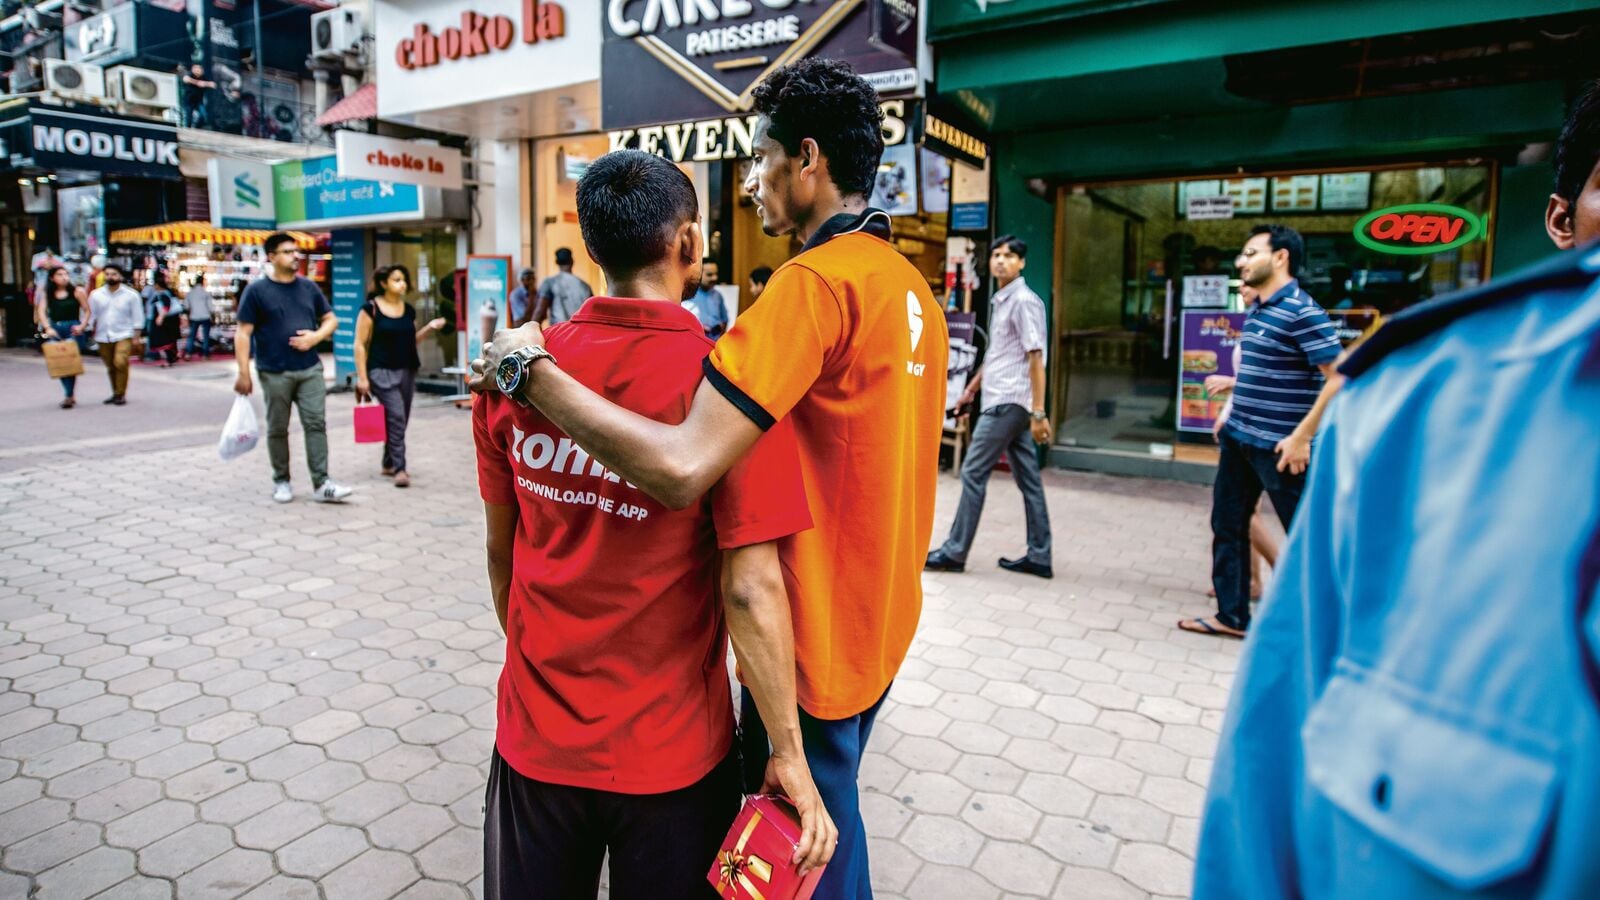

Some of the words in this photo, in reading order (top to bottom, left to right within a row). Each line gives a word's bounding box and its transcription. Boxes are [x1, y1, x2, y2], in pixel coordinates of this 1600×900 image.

[395, 10, 514, 70] choko
[522, 0, 565, 44] la
[686, 14, 800, 56] PATISSERIE
[33, 125, 180, 166] MODLUK
[367, 150, 424, 170] choko
[428, 156, 445, 174] la
[1371, 214, 1464, 243] OPEN
[517, 475, 597, 506] DOWNLOAD
[616, 502, 649, 521] APP
